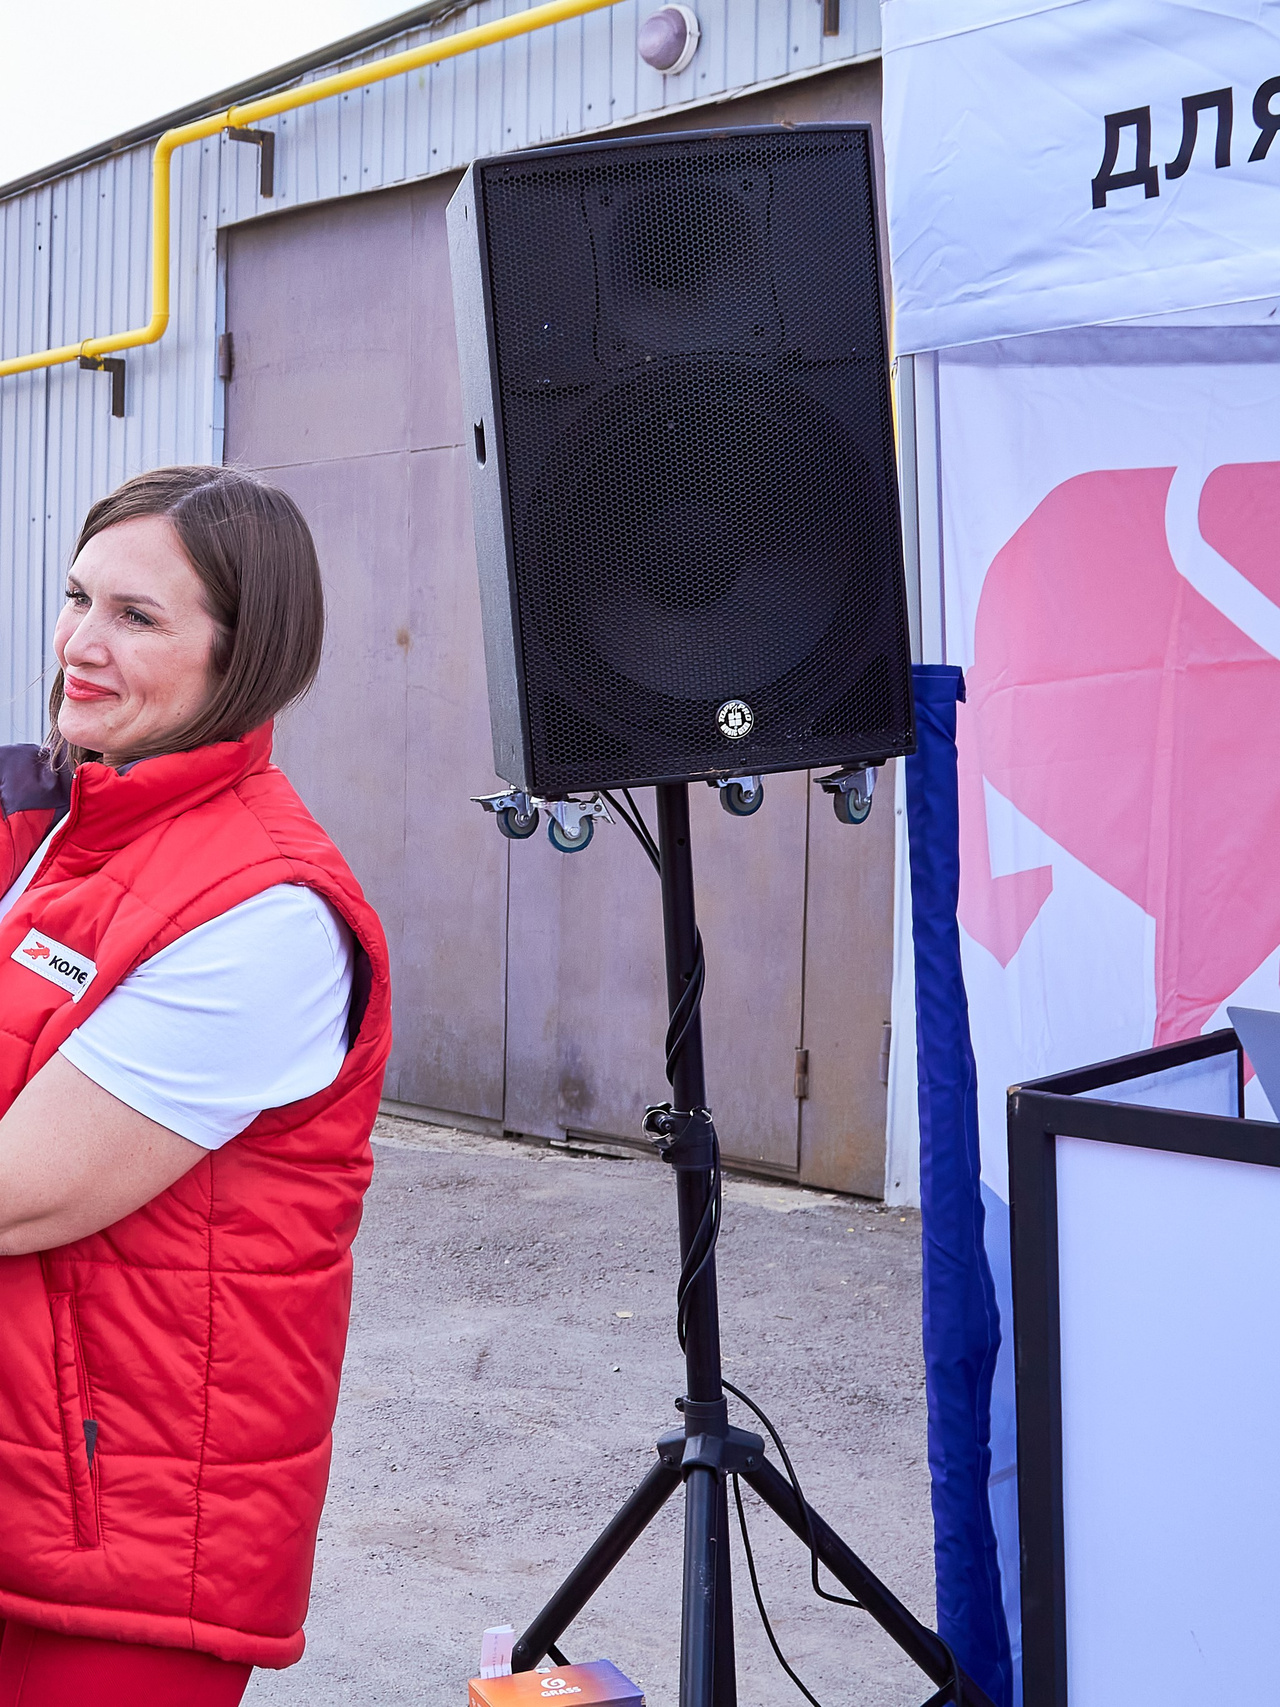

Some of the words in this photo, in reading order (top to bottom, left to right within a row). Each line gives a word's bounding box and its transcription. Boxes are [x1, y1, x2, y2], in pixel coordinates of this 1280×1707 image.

[1091, 75, 1280, 210] ДЛЯ
[718, 702, 736, 723] TOPP
[737, 703, 752, 722] PRO
[48, 955, 88, 984] коле
[540, 1685, 582, 1698] GRASS
